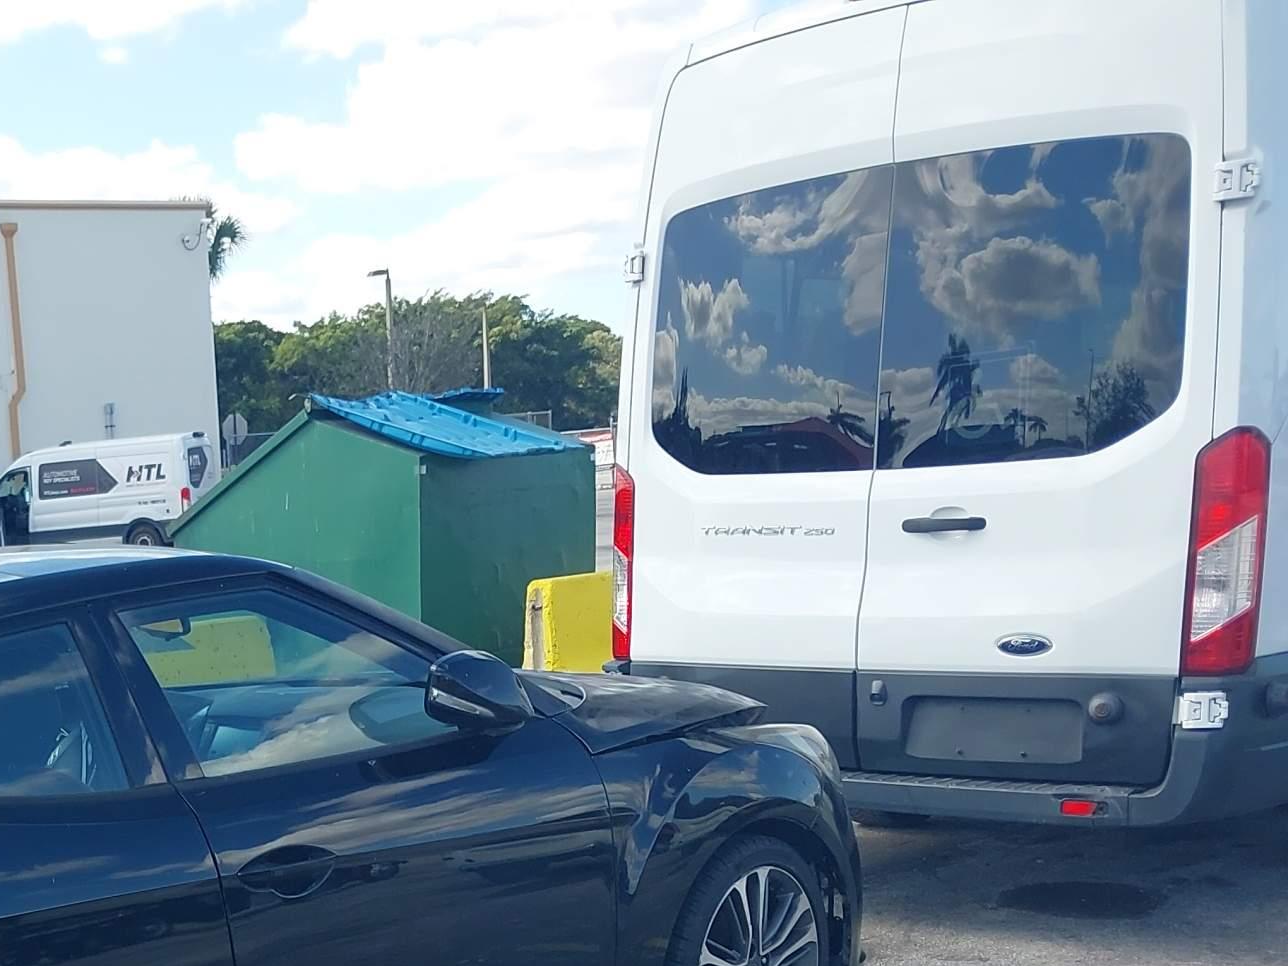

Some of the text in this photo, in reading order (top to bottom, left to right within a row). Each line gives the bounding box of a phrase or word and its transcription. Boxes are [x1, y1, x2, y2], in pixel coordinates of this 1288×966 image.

[126, 463, 166, 483] HTL
[701, 525, 835, 536] TRANSIT 250
